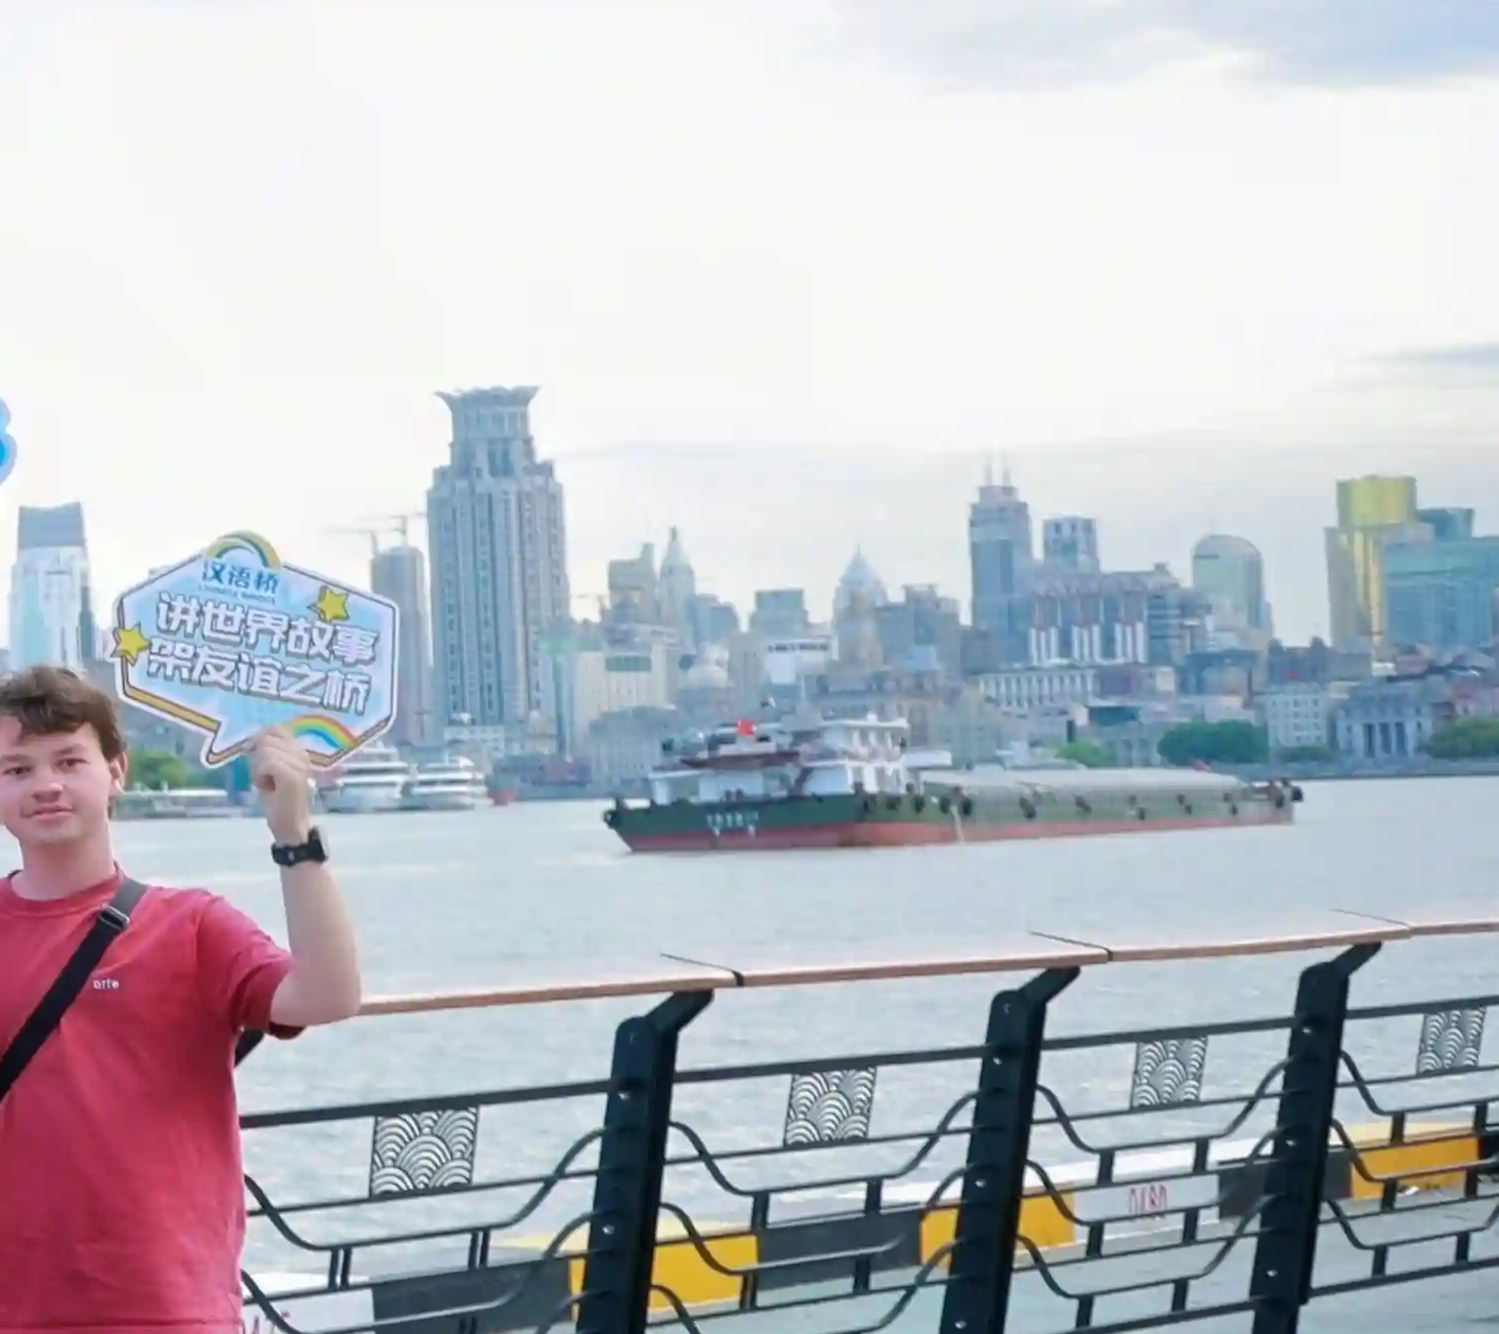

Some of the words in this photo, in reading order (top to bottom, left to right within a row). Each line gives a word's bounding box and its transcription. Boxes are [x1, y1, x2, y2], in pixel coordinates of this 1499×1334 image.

[156, 591, 379, 665] 讲世界故事
[147, 637, 373, 716] 架友谊之桥
